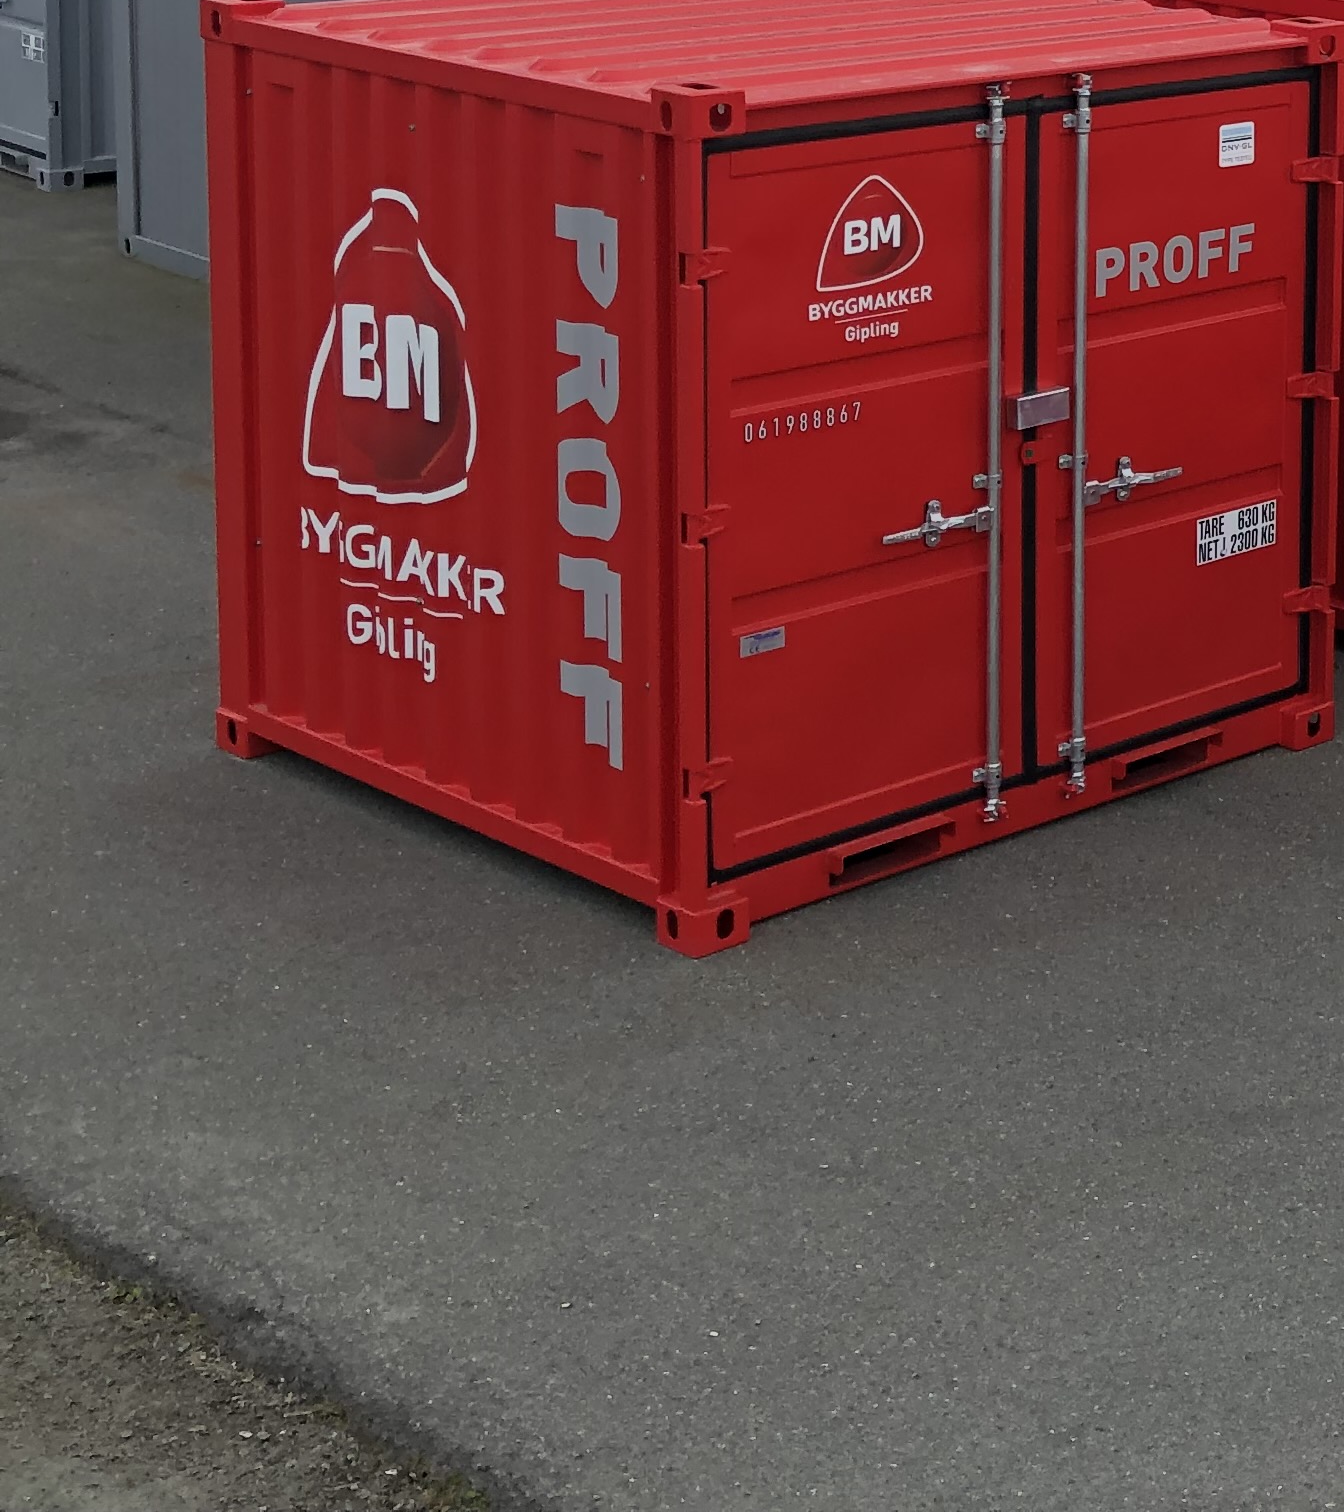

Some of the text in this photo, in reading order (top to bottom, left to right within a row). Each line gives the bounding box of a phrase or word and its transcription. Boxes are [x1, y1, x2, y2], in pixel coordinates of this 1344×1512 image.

[843, 214, 901, 255] BM
[1095, 223, 1256, 298] PROFF
[808, 285, 934, 322] BYGGMAKKER
[845, 321, 900, 343] Gipling
[342, 303, 440, 423] BM
[554, 203, 623, 771] PROFF
[1198, 501, 1275, 541] TARE 630 KG
[1198, 523, 1275, 564] NET 2300 KG
